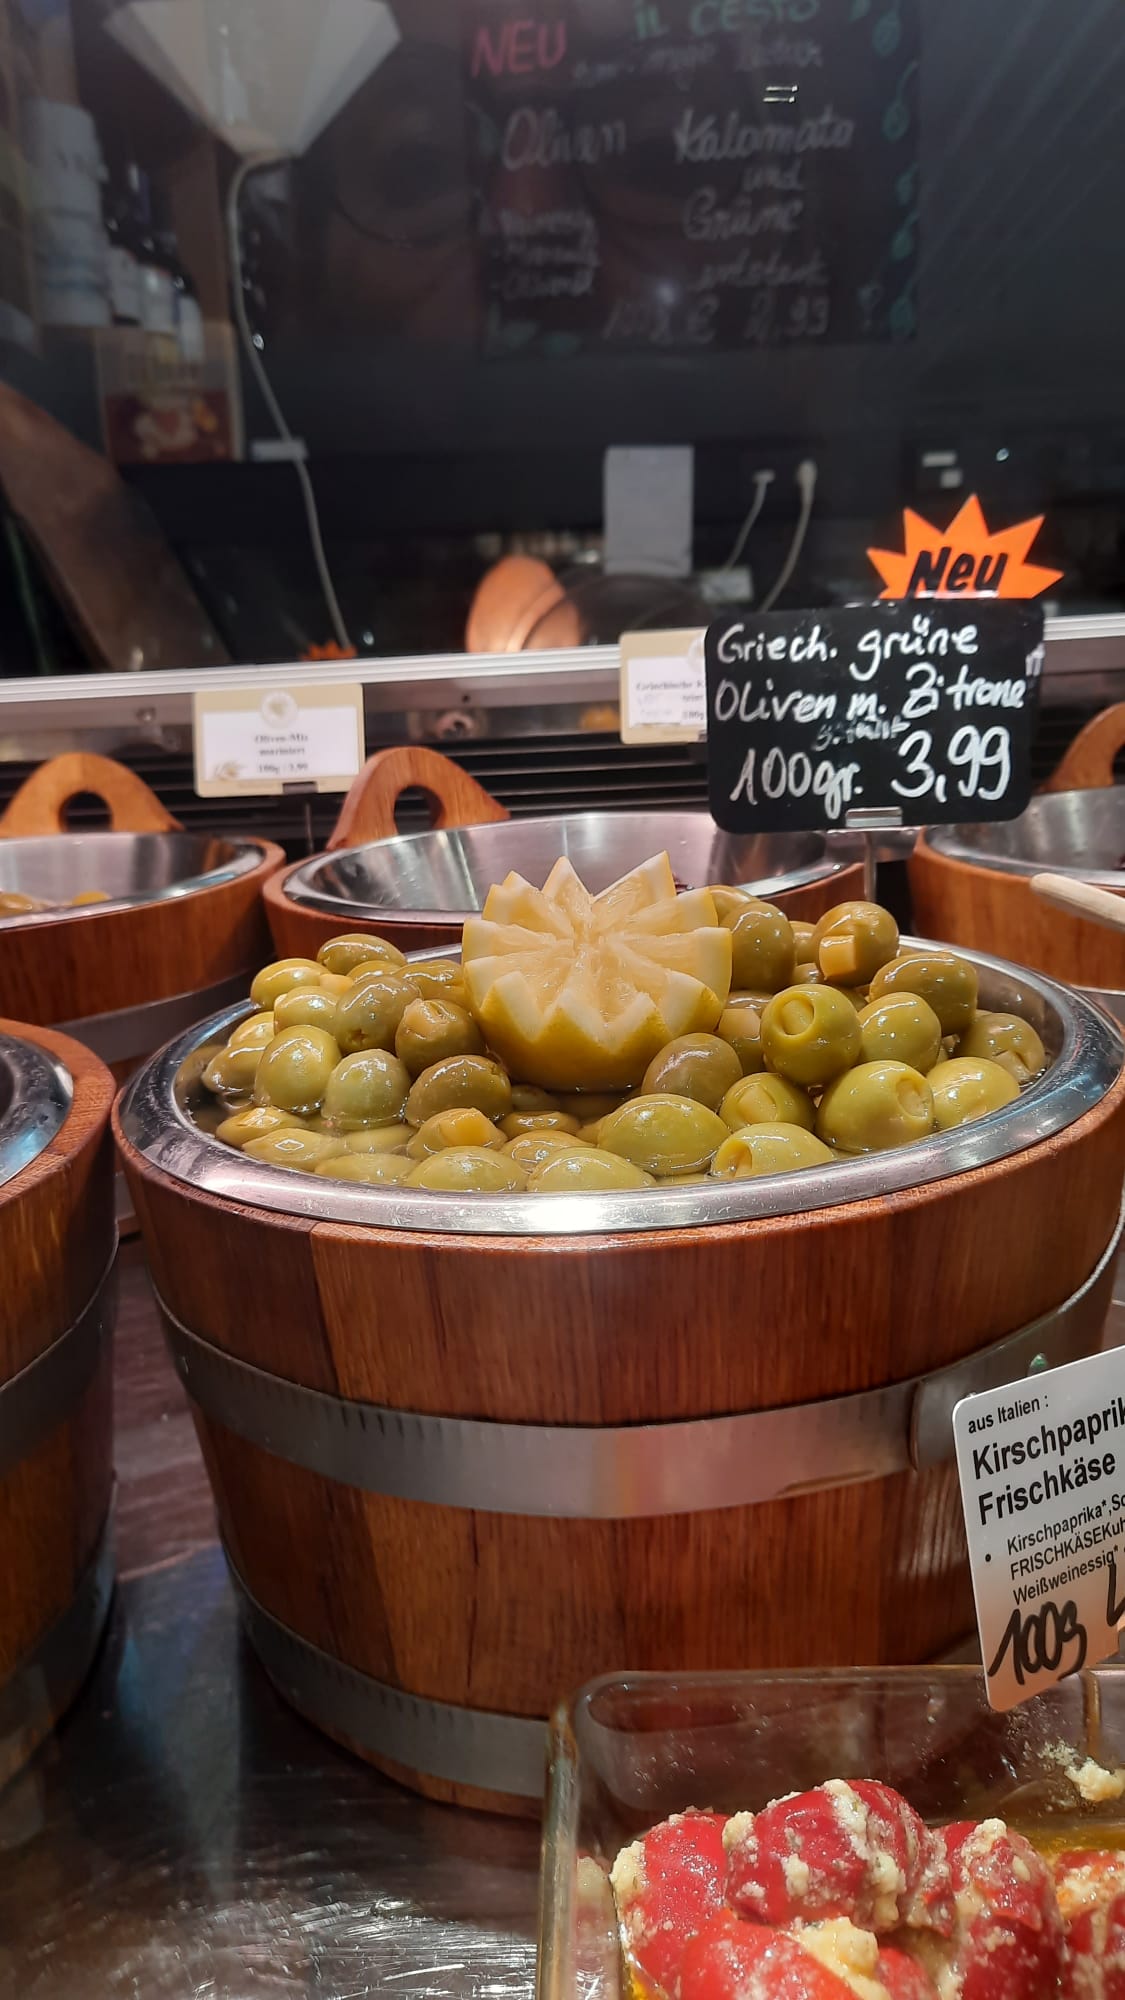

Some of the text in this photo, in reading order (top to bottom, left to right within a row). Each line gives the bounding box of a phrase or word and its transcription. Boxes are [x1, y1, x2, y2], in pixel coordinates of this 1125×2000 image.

[471, 20, 567, 78] NEU
[907, 546, 1009, 599] Neu
[717, 623, 838, 665] Griech.
[849, 614, 979, 681] grüne
[846, 691, 888, 723] m.
[902, 662, 1028, 720] Zitrone
[730, 726, 1012, 819] 100gr. 3,99
[967, 1413, 995, 1435] aus
[997, 1396, 1042, 1425] Italien
[978, 1452, 1117, 1526] Frischkäse
